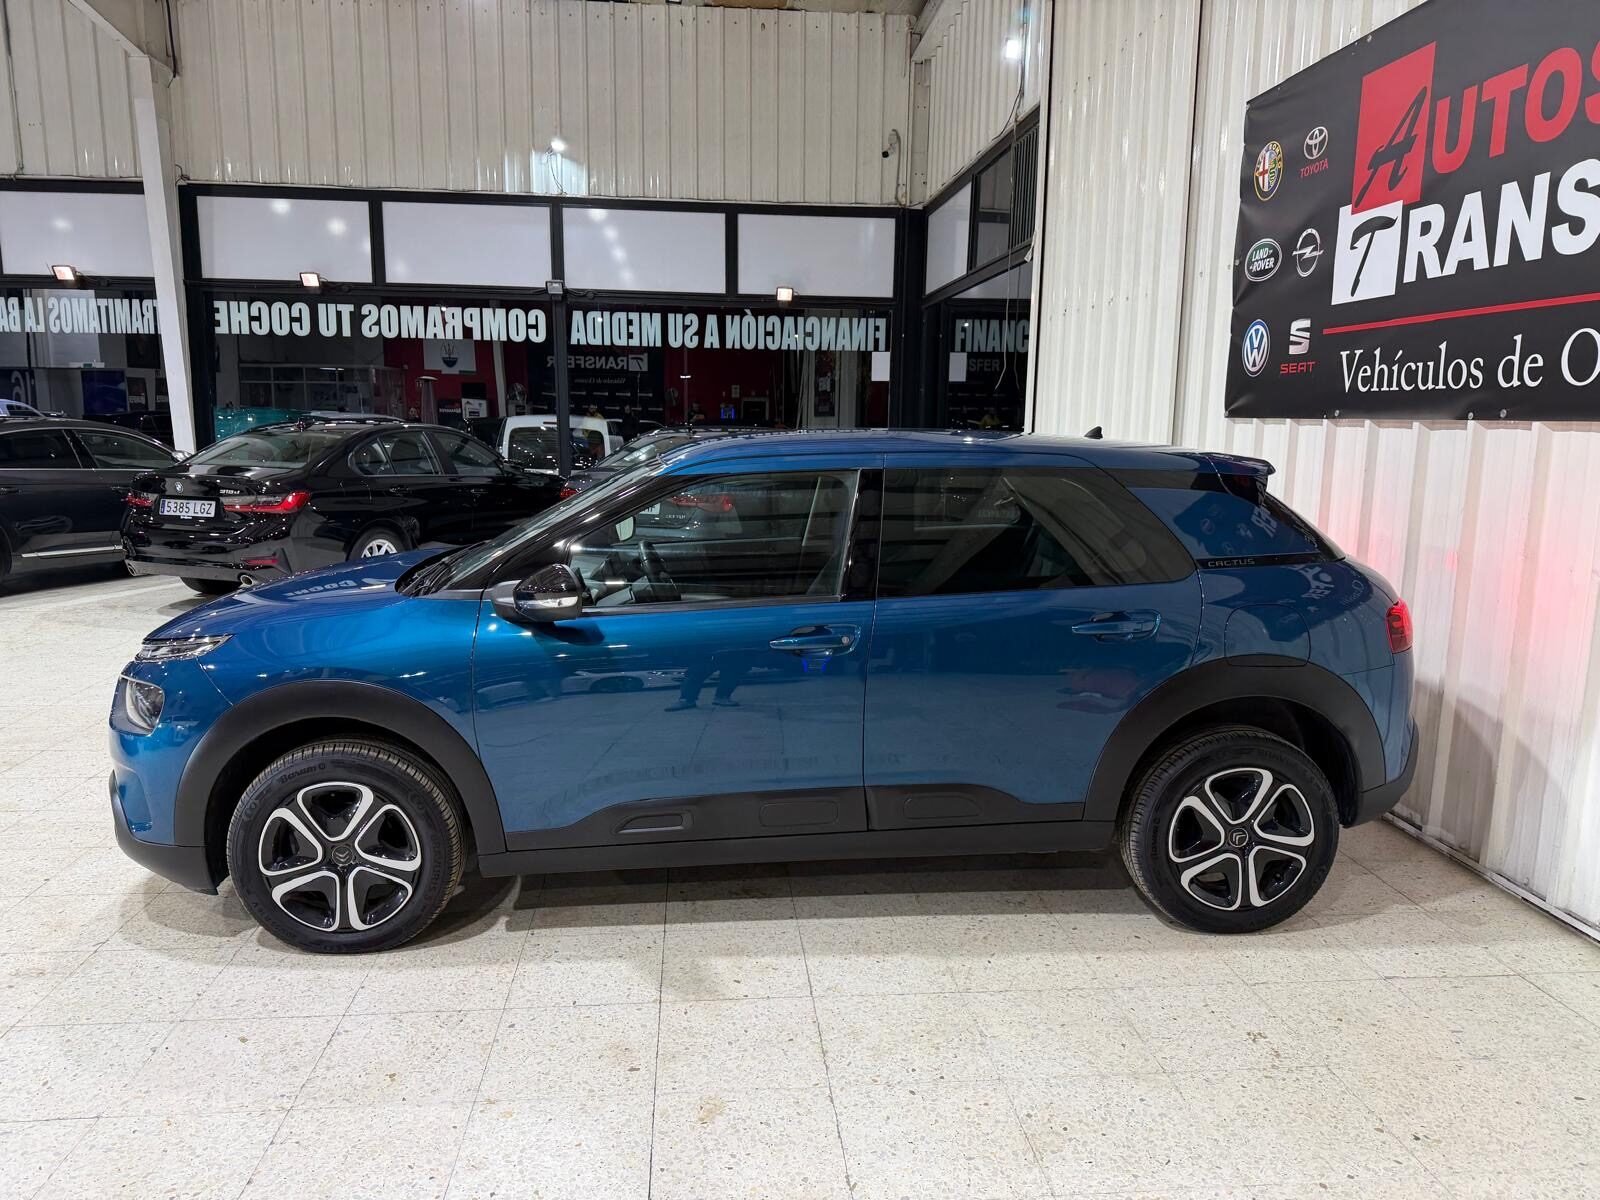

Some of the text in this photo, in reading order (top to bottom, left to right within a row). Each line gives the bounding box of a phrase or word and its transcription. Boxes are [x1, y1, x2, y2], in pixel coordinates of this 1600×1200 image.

[1352, 40, 1600, 208] AUTO
[1300, 158, 1328, 179] TOYOTA
[1252, 248, 1269, 261] LAND
[1253, 259, 1275, 273] ROVER
[1280, 361, 1316, 374] SEAT
[1340, 341, 1484, 393] Vehículos
[1497, 334, 1544, 388] de
[166, 501, 212, 515] 5385 LGZ
[1207, 558, 1256, 568] CACTUS
